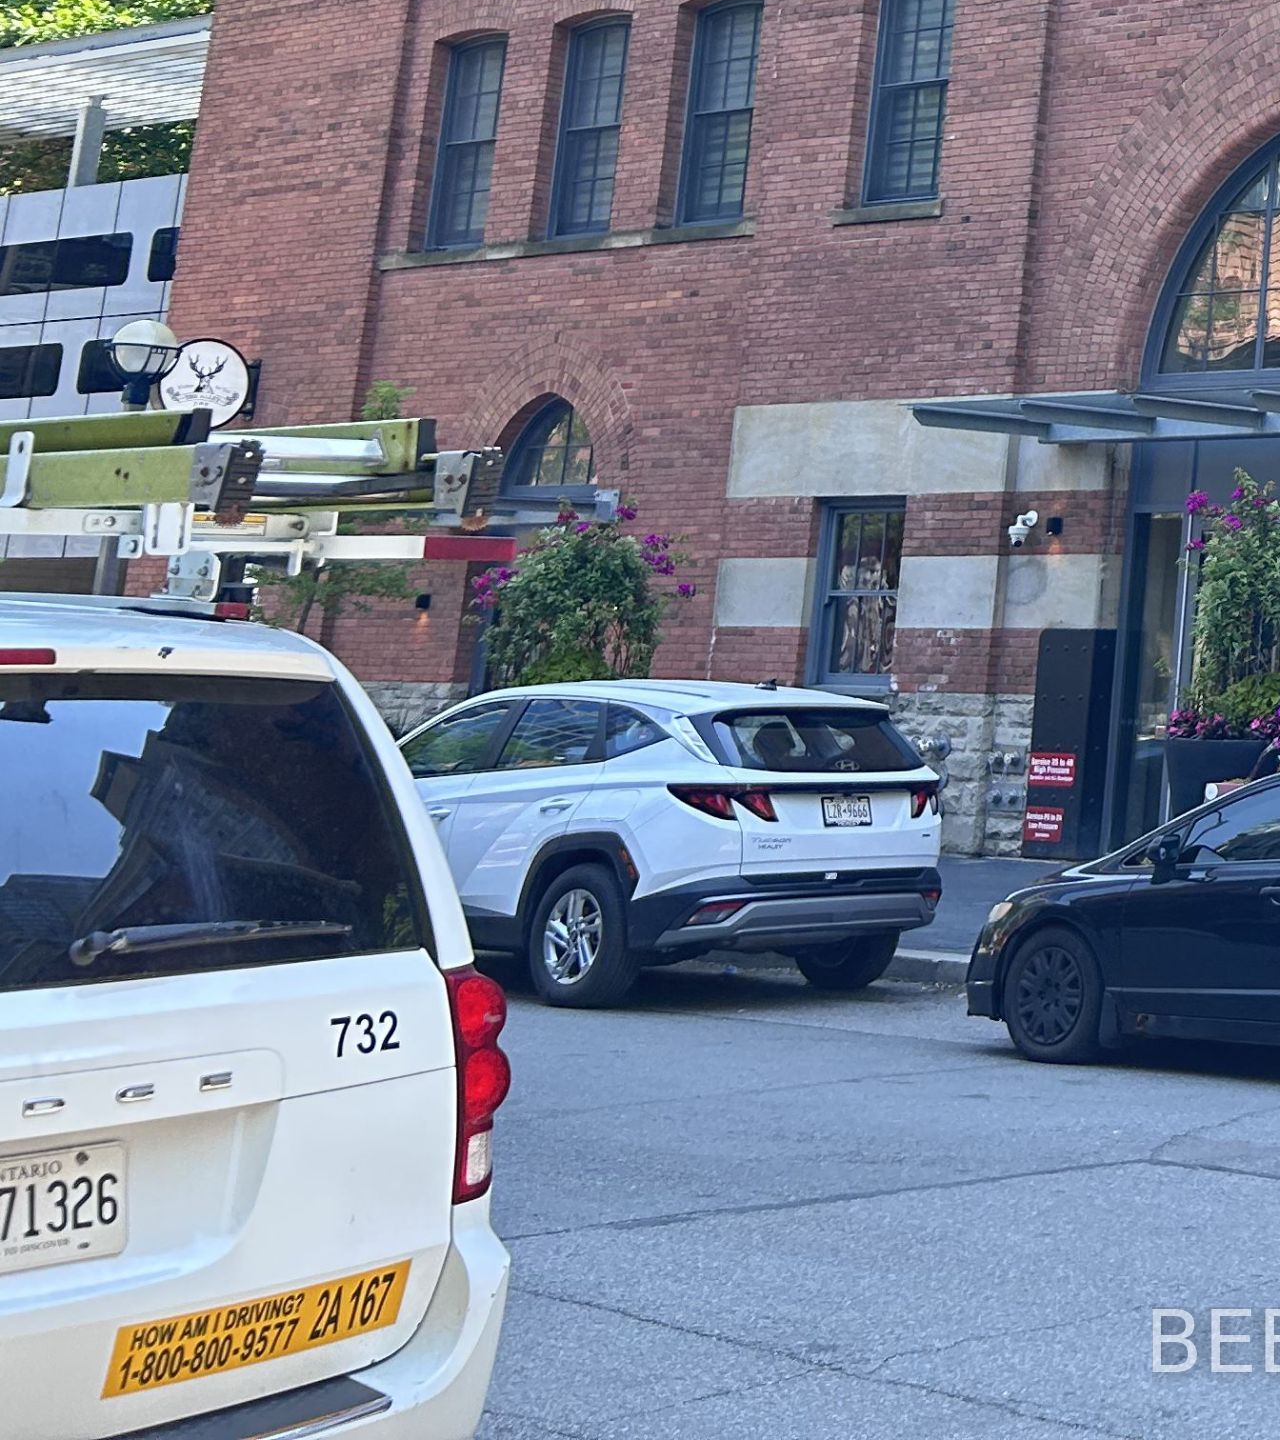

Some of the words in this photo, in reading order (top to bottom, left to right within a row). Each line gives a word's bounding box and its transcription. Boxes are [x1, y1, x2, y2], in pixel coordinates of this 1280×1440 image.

[330, 1010, 400, 1058] 732
[0, 1173, 118, 1240] 71326
[130, 1321, 178, 1351] HOW
[180, 1315, 209, 1343] AM
[211, 1313, 221, 1335] I
[223, 1293, 305, 1330] DRIVING?
[308, 1285, 343, 1342] 2A
[347, 1272, 397, 1330] 167
[119, 1317, 301, 1390] 1-800-800-9577
